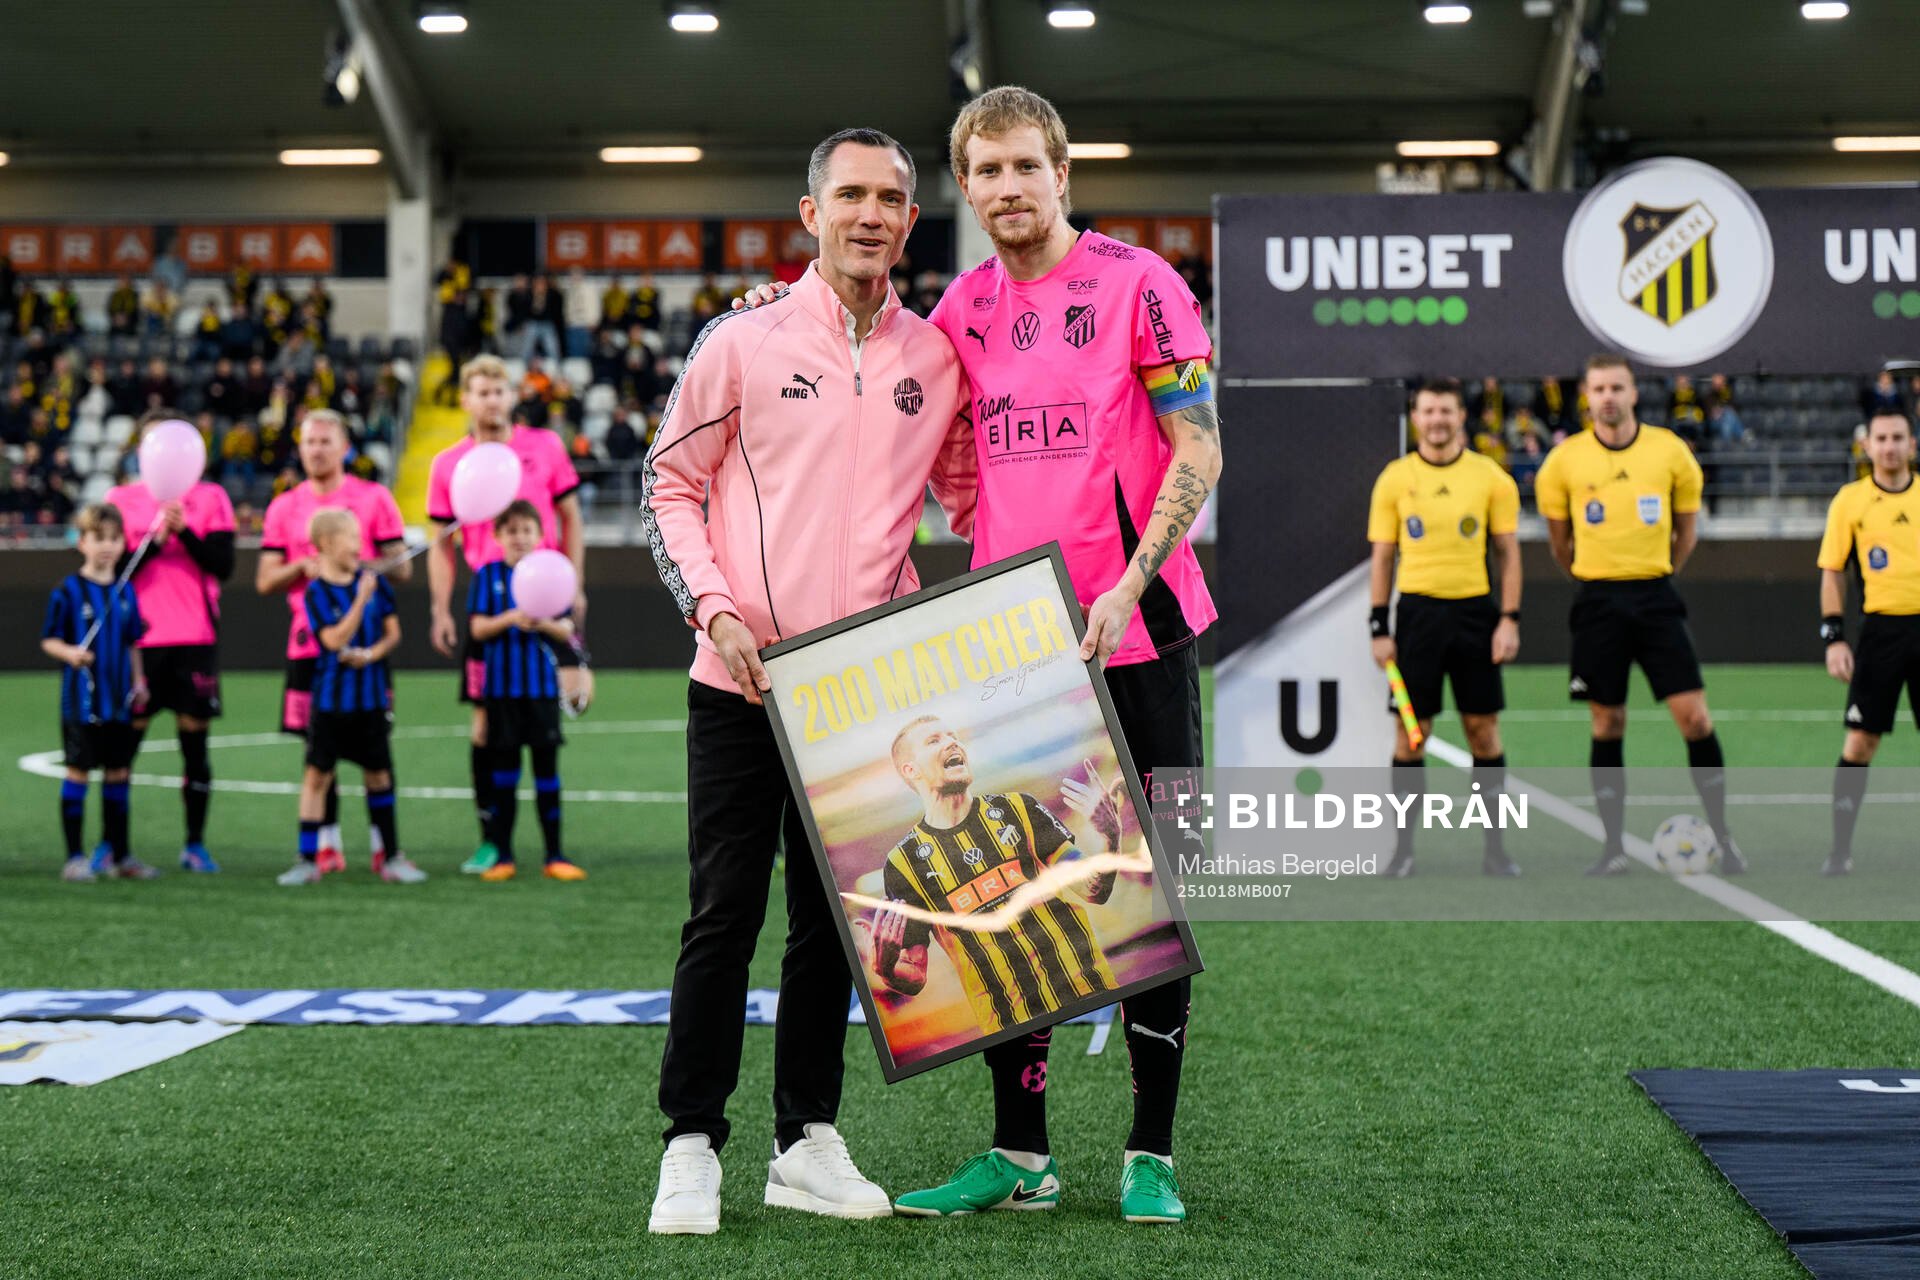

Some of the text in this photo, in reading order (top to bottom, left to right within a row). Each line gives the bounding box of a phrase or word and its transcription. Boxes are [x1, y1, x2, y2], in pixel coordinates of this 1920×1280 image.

[9, 233, 148, 263] BRA
[187, 233, 325, 262] BRA
[555, 228, 695, 258] BRA
[1088, 244, 1136, 260] WELLNESS
[1265, 234, 1513, 292] UNIBET
[1067, 279, 1098, 290] EXE
[781, 387, 808, 399] KING
[977, 393, 1015, 424] Team
[793, 597, 1068, 744] 200 MATCHER
[1279, 680, 1338, 755] U
